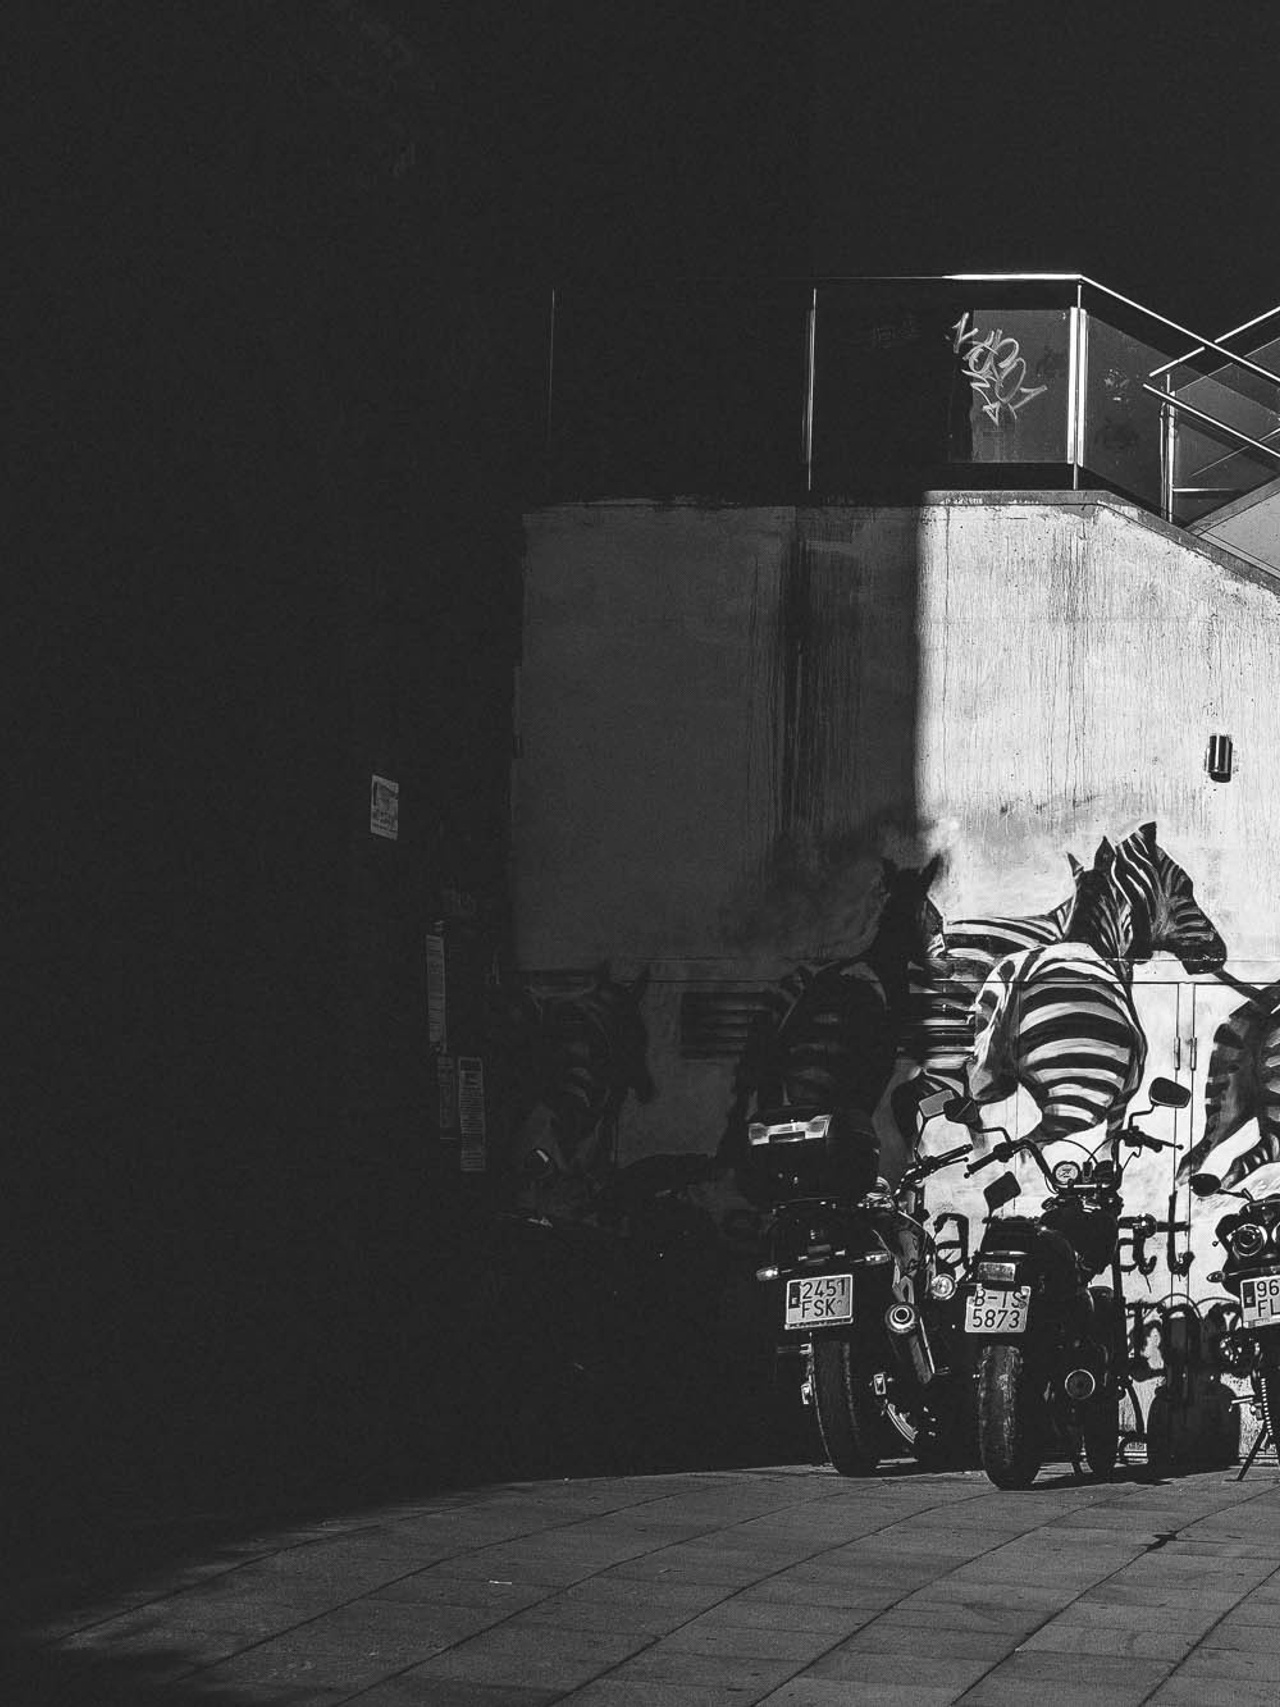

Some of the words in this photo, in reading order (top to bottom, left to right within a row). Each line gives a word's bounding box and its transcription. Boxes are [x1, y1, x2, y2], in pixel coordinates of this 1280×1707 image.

[801, 1278, 846, 1299] 2451
[801, 1297, 836, 1318] FSK
[972, 1308, 1021, 1329] 5873
